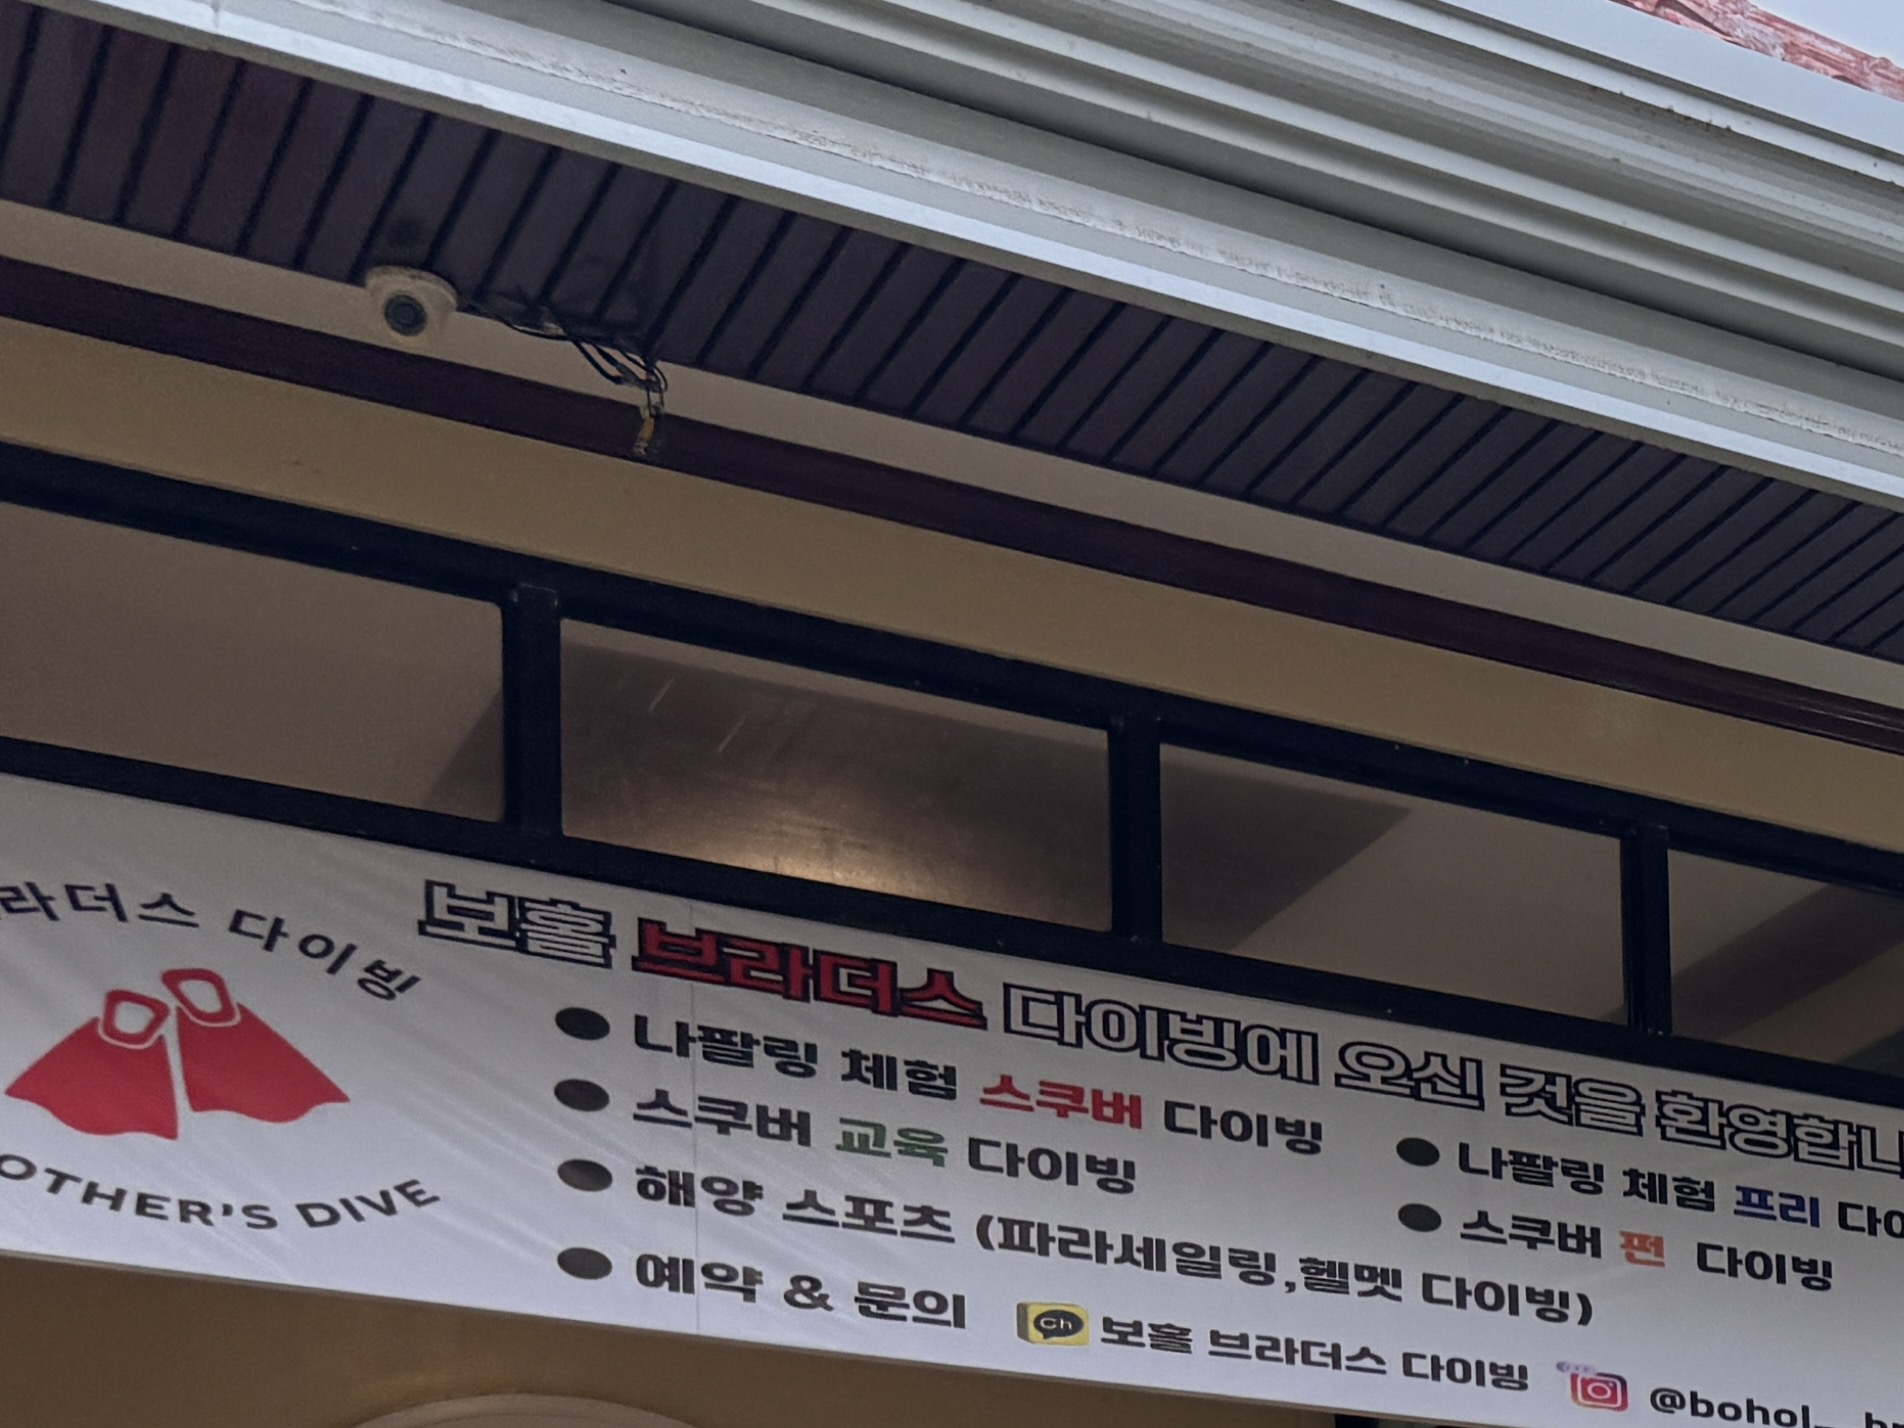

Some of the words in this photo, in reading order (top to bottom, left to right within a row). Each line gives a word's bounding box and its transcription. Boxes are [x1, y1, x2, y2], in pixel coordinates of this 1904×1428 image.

[228, 908, 422, 1001] 다이빙
[418, 879, 616, 969] 보홀
[631, 916, 988, 1031] 브라더스
[1003, 982, 1319, 1086] 다이빙에
[1335, 1040, 1485, 1111] 오신
[1500, 1062, 1644, 1137] 것을
[634, 1014, 818, 1079] 나팔링
[841, 1048, 958, 1101] 체험
[979, 1073, 1143, 1129] 스쿠버
[1163, 1099, 1323, 1156] 다이빙
[633, 1088, 812, 1148] 스쿠버
[835, 1116, 949, 1168] 교육
[967, 1136, 1136, 1194] 다이빙
[295, 1178, 441, 1229] DIVE
[635, 1165, 763, 1217] 해양
[782, 1188, 956, 1244] 스포츠
[1458, 1141, 1605, 1197] 나팔링
[1622, 1167, 1716, 1213] 체험
[1733, 1184, 1821, 1228] 프리
[635, 1253, 763, 1303] 예약
[783, 1273, 834, 1313] &
[854, 1280, 966, 1330] 문의
[1459, 1210, 1602, 1259] 스쿠버
[1620, 1230, 1666, 1269] 펀
[1696, 1241, 1833, 1292] 다이빙
[1101, 1316, 1193, 1355] 보홀
[1207, 1328, 1387, 1376] 브라더스
[1401, 1351, 1529, 1392] 다이빙
